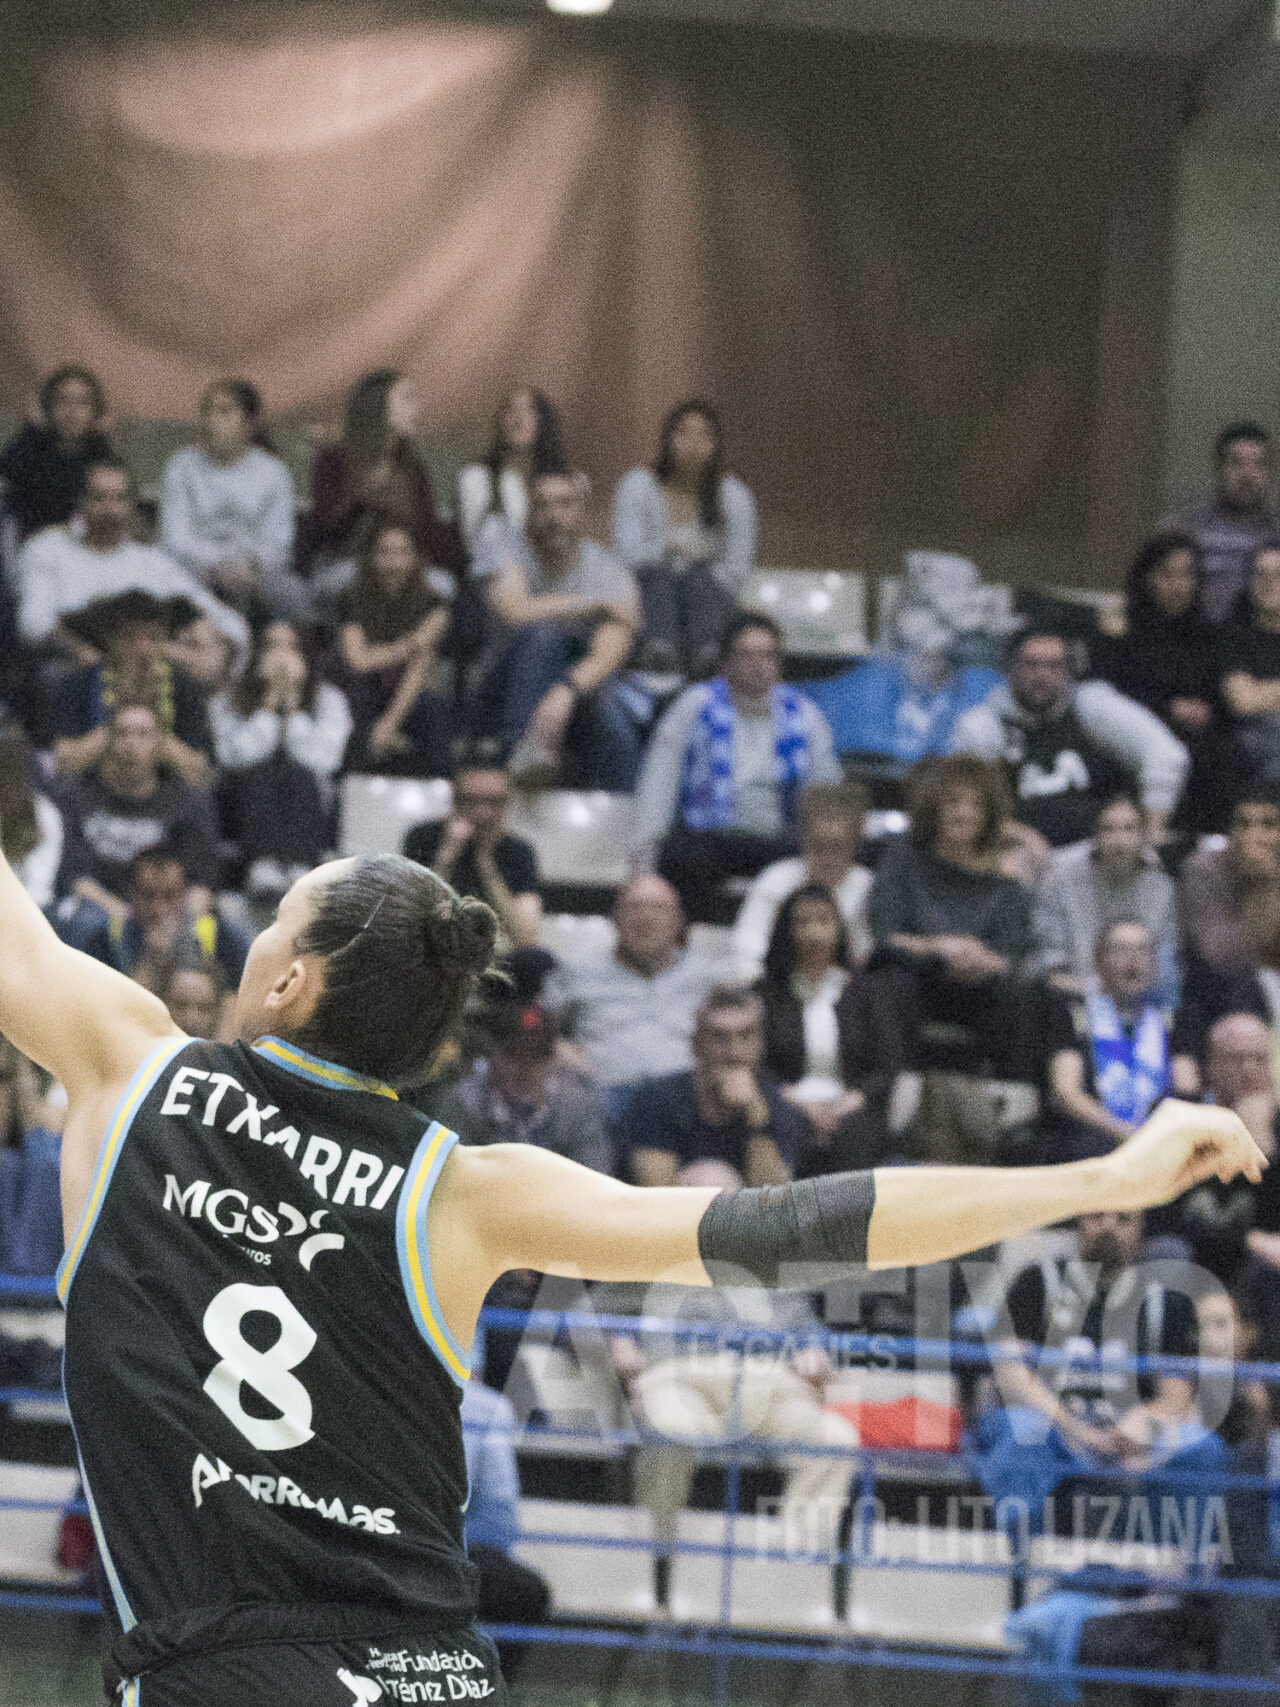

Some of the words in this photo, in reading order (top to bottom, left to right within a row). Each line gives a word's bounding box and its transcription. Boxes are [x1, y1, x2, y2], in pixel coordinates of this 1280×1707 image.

[160, 1066, 406, 1211] ETXARRI
[162, 1174, 280, 1244] MGS
[202, 1282, 318, 1451] 8
